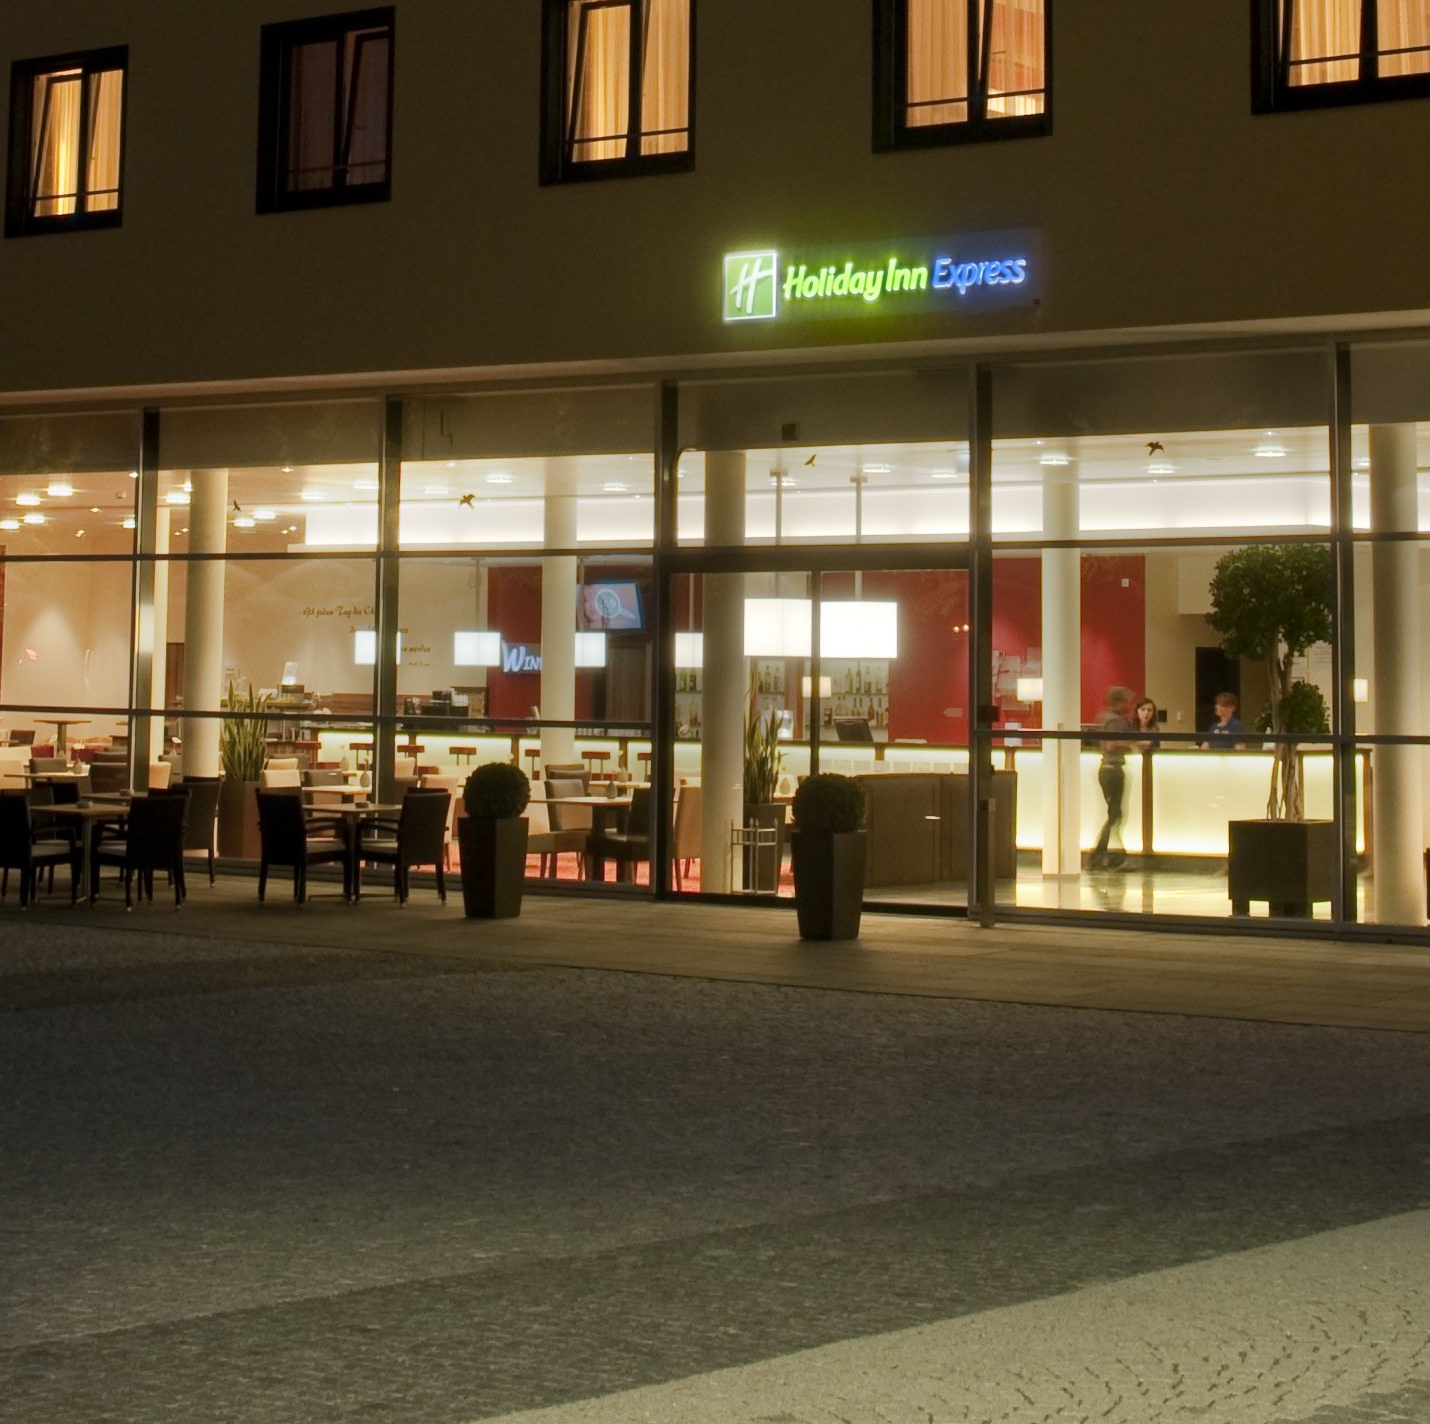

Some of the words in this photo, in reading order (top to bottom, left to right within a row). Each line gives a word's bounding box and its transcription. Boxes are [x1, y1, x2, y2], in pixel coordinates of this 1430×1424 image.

[783, 262, 883, 304] Holiday
[885, 257, 928, 292] Inn
[932, 257, 1027, 296] Express
